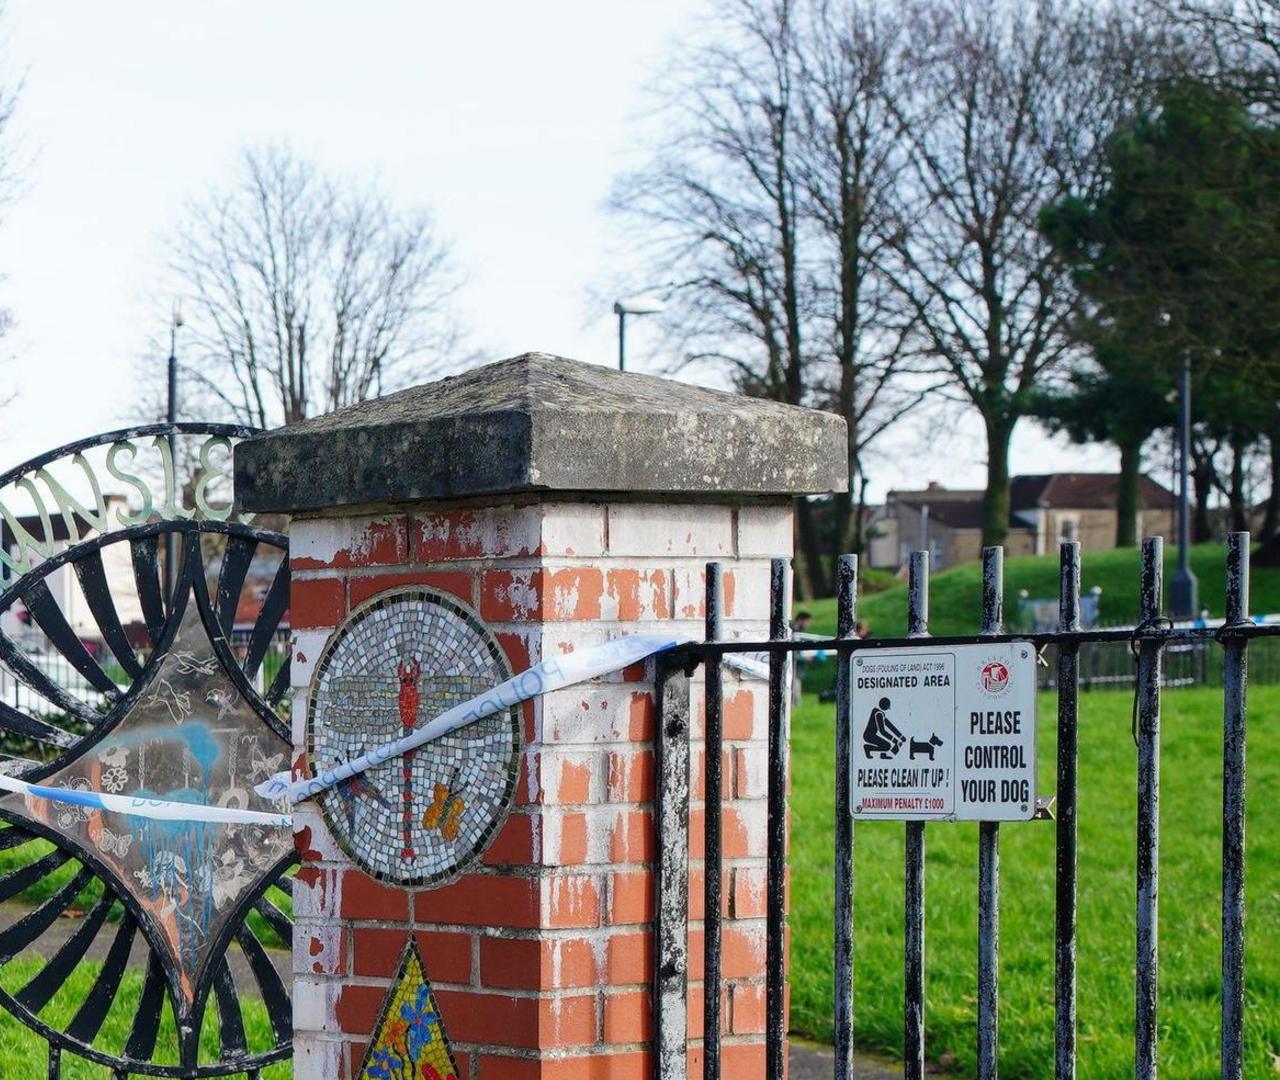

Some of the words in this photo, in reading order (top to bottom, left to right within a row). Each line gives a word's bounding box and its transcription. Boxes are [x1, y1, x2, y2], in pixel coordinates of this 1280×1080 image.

[858, 676, 918, 689] DESIGNATED
[924, 675, 950, 687] AREA
[970, 711, 1021, 734] PLEASE
[964, 745, 1026, 768] CONTROL
[858, 769, 889, 788] PLEASE
[890, 768, 919, 788] CLEAN
[921, 768, 929, 786] IT
[930, 768, 944, 786] UP
[961, 780, 996, 802] YOUR
[1001, 779, 1029, 803] DOG
[862, 798, 893, 809] MAXIMUM
[894, 797, 922, 809] PENALTY
[924, 798, 944, 809] £1000
